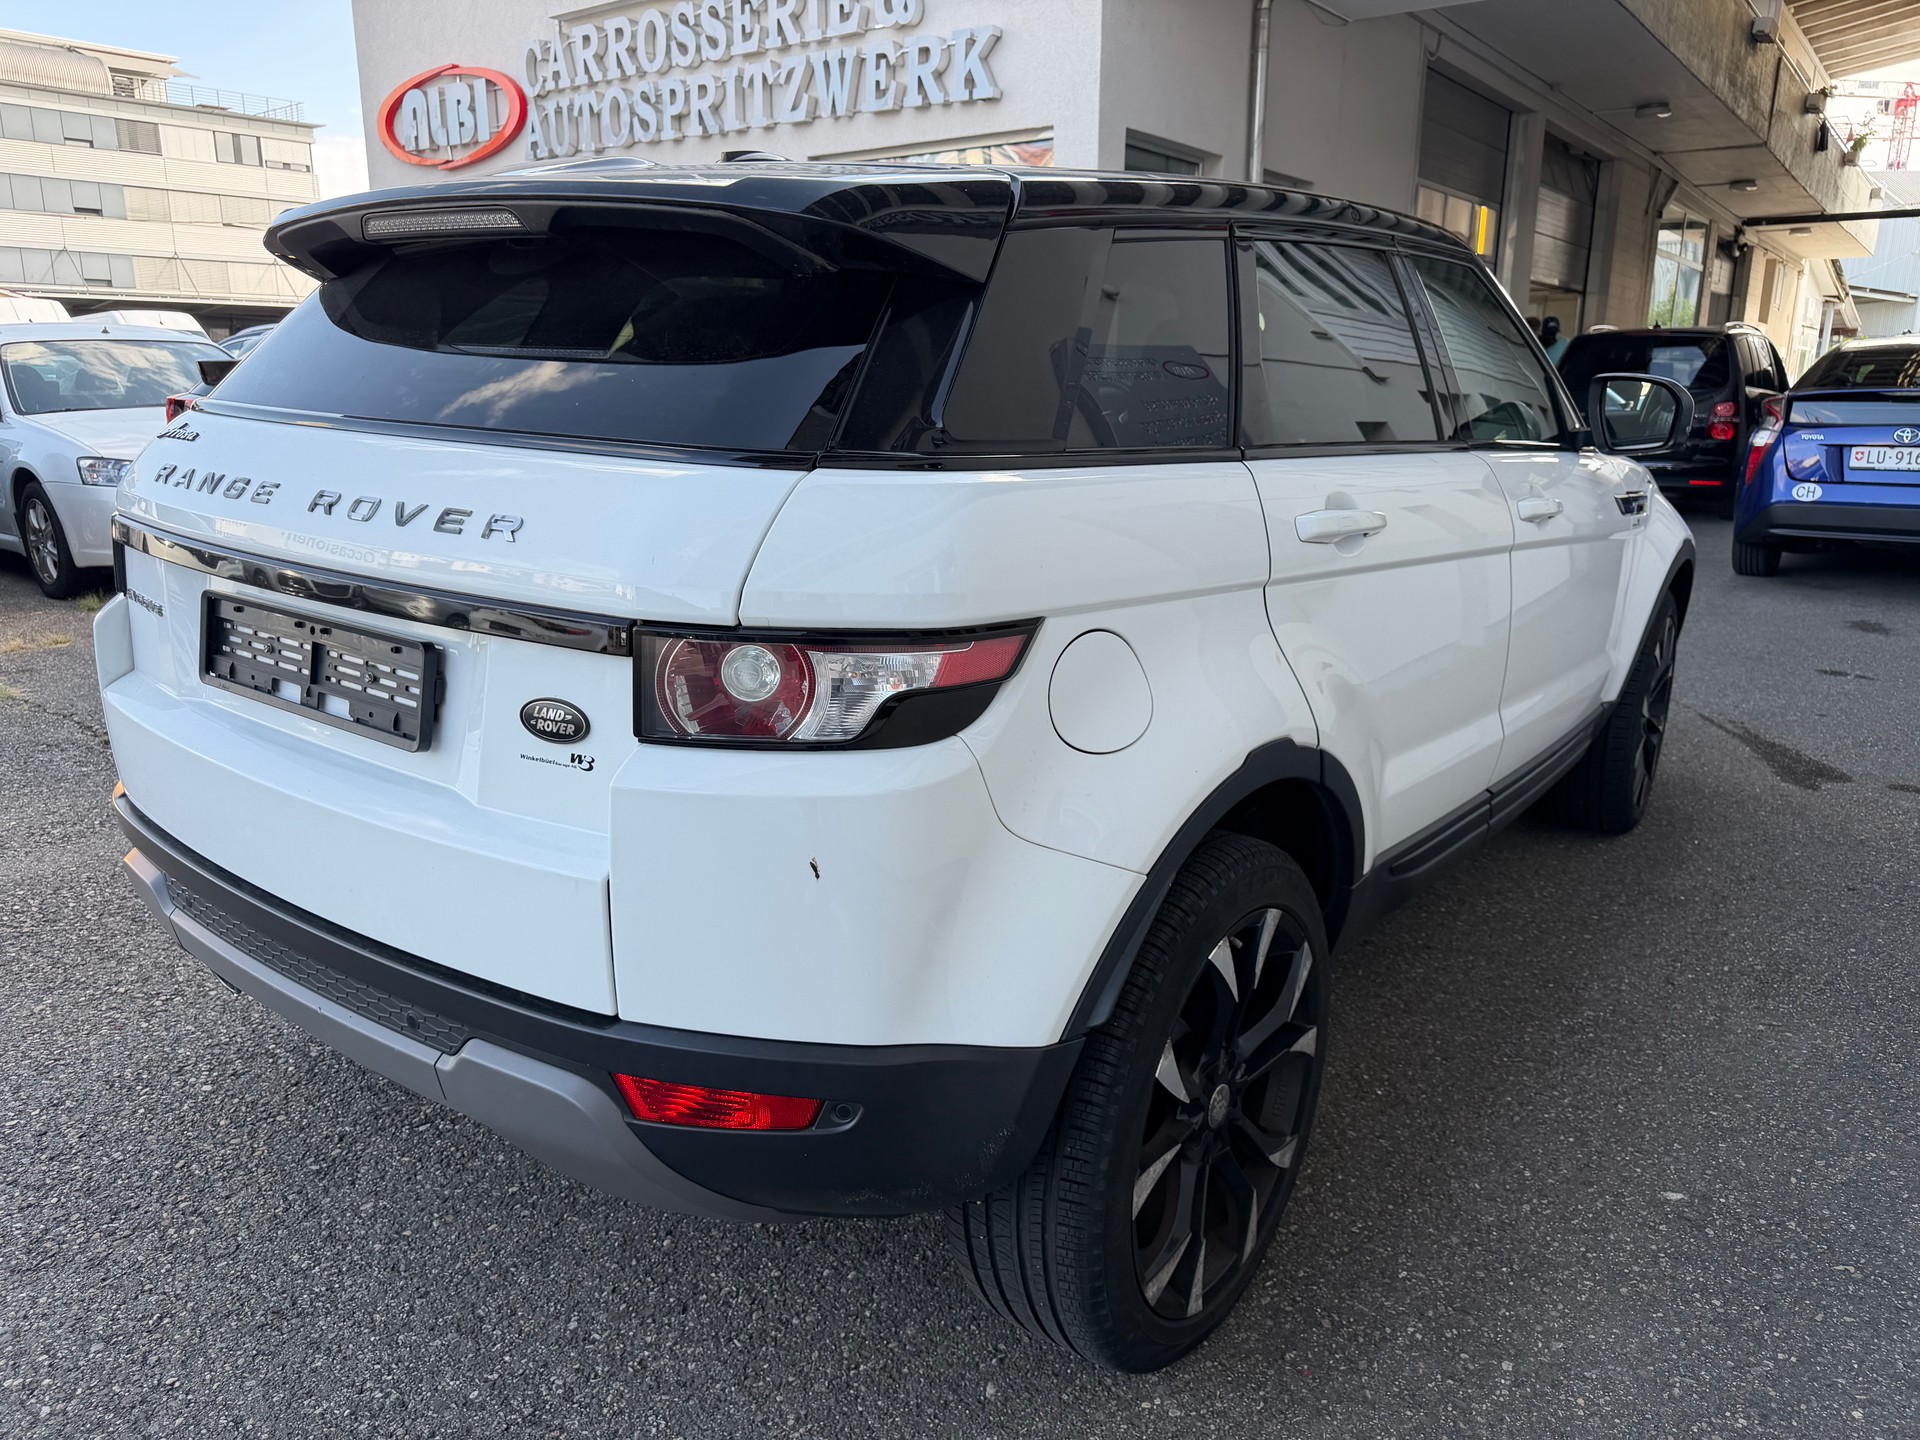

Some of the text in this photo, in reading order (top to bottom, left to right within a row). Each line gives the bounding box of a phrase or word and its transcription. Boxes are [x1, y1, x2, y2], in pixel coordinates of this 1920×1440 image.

[519, 0, 865, 98] CARROSSERIE
[401, 78, 491, 151] ALBI
[525, 25, 1001, 161] AUTOSPRITZWERK
[1801, 433, 1825, 441] TOYOTA
[153, 462, 525, 543] RANGE ROVER
[1796, 486, 1817, 499] CH
